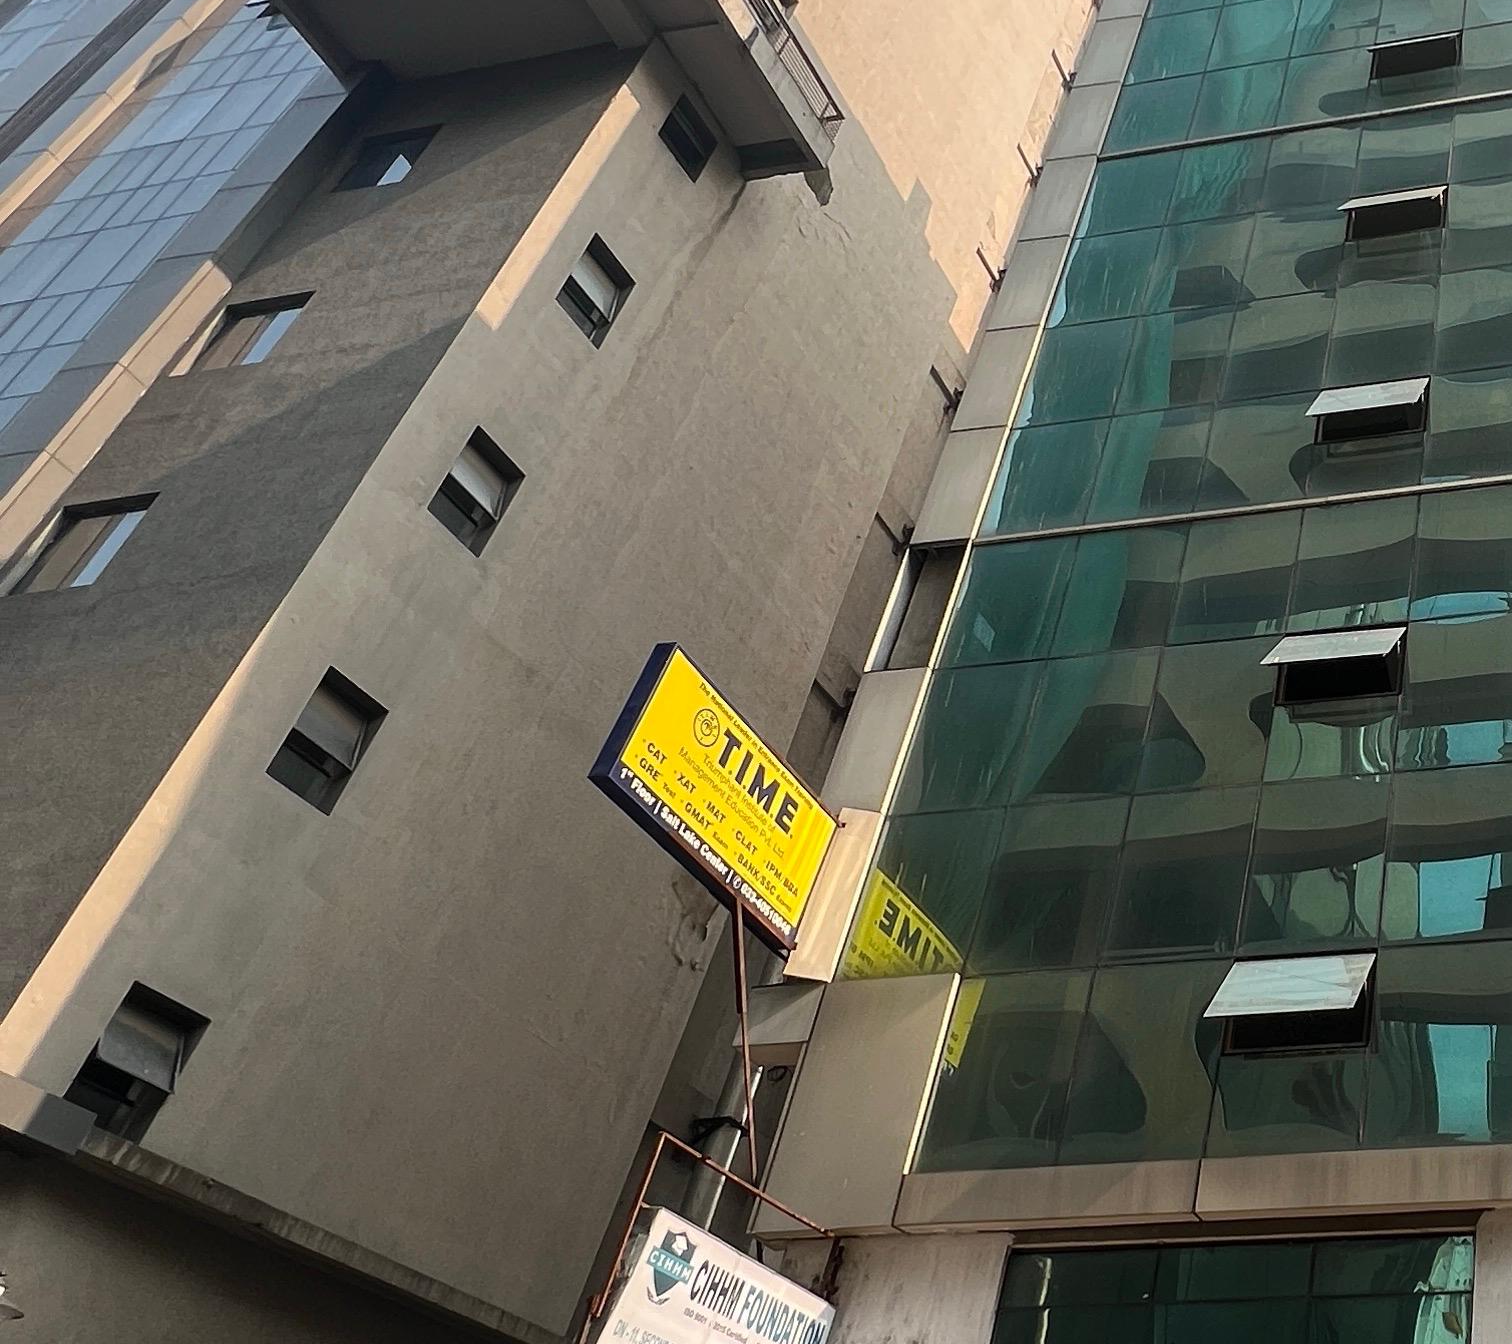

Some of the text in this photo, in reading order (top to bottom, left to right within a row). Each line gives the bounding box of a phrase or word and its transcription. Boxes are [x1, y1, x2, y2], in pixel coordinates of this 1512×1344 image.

[639, 757, 661, 782] GRE
[647, 742, 668, 765] CAT
[676, 772, 697, 794] XAT
[706, 800, 727, 824] MAT
[735, 829, 758, 856] CLAT
[718, 728, 799, 839] T.I.M.E.
[630, 777, 657, 806] Floor
[660, 805, 681, 830] Salt
[678, 823, 701, 850] Lake
[699, 843, 729, 875] Center
[649, 1250, 689, 1282] CIHHM
[690, 1259, 746, 1321] CIHHM
